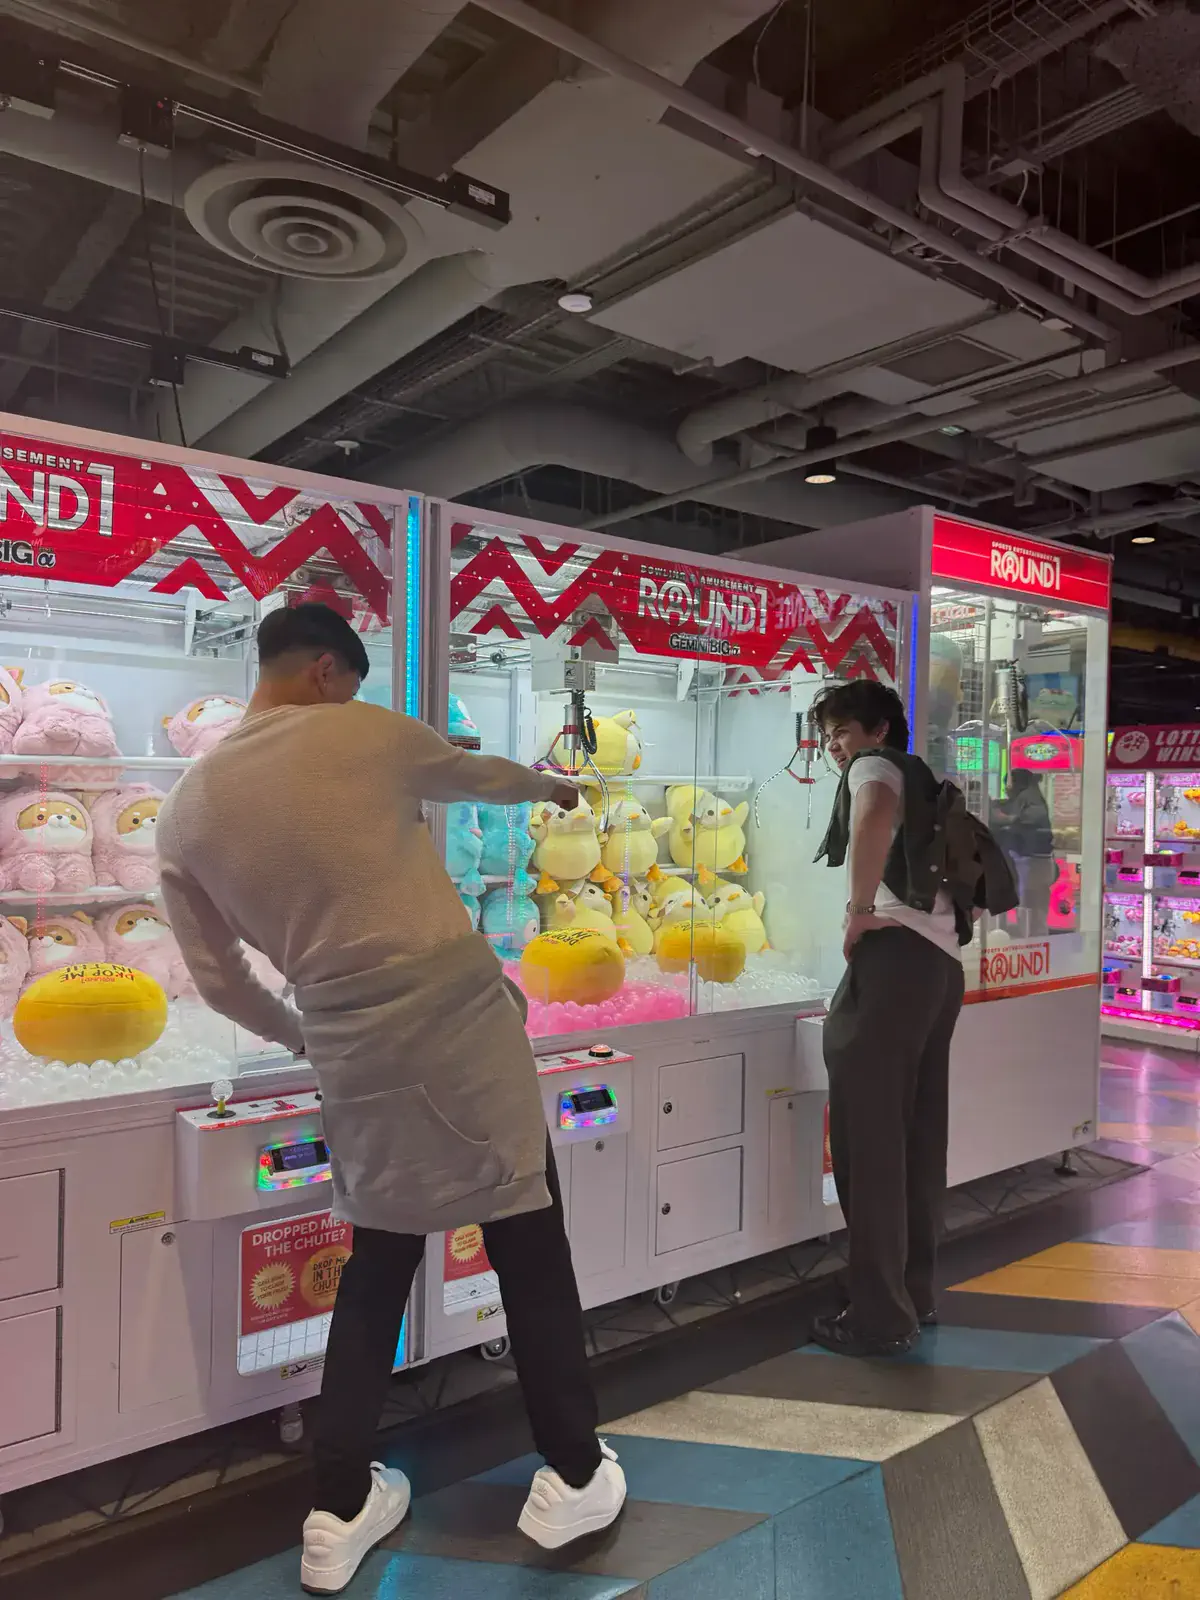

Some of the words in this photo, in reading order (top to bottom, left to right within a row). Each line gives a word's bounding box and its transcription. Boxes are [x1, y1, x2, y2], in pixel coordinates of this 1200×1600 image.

[0, 446, 84, 472] SEMENT
[990, 549, 1060, 591] ROUND1
[700, 575, 755, 593] AMUSEMENT
[637, 577, 768, 635] ROUND1
[1155, 729, 1200, 746] LOTT
[979, 941, 1050, 985] ROUND1
[92, 969, 135, 981] DROP
[252, 1221, 318, 1246] DROPPED
[264, 1241, 292, 1258] THE
[294, 1228, 346, 1250] CHUTE?
[313, 1270, 323, 1282] IN
[326, 1264, 341, 1279] TH
[314, 1257, 332, 1270] DROP
[313, 1277, 338, 1291] CHUT
